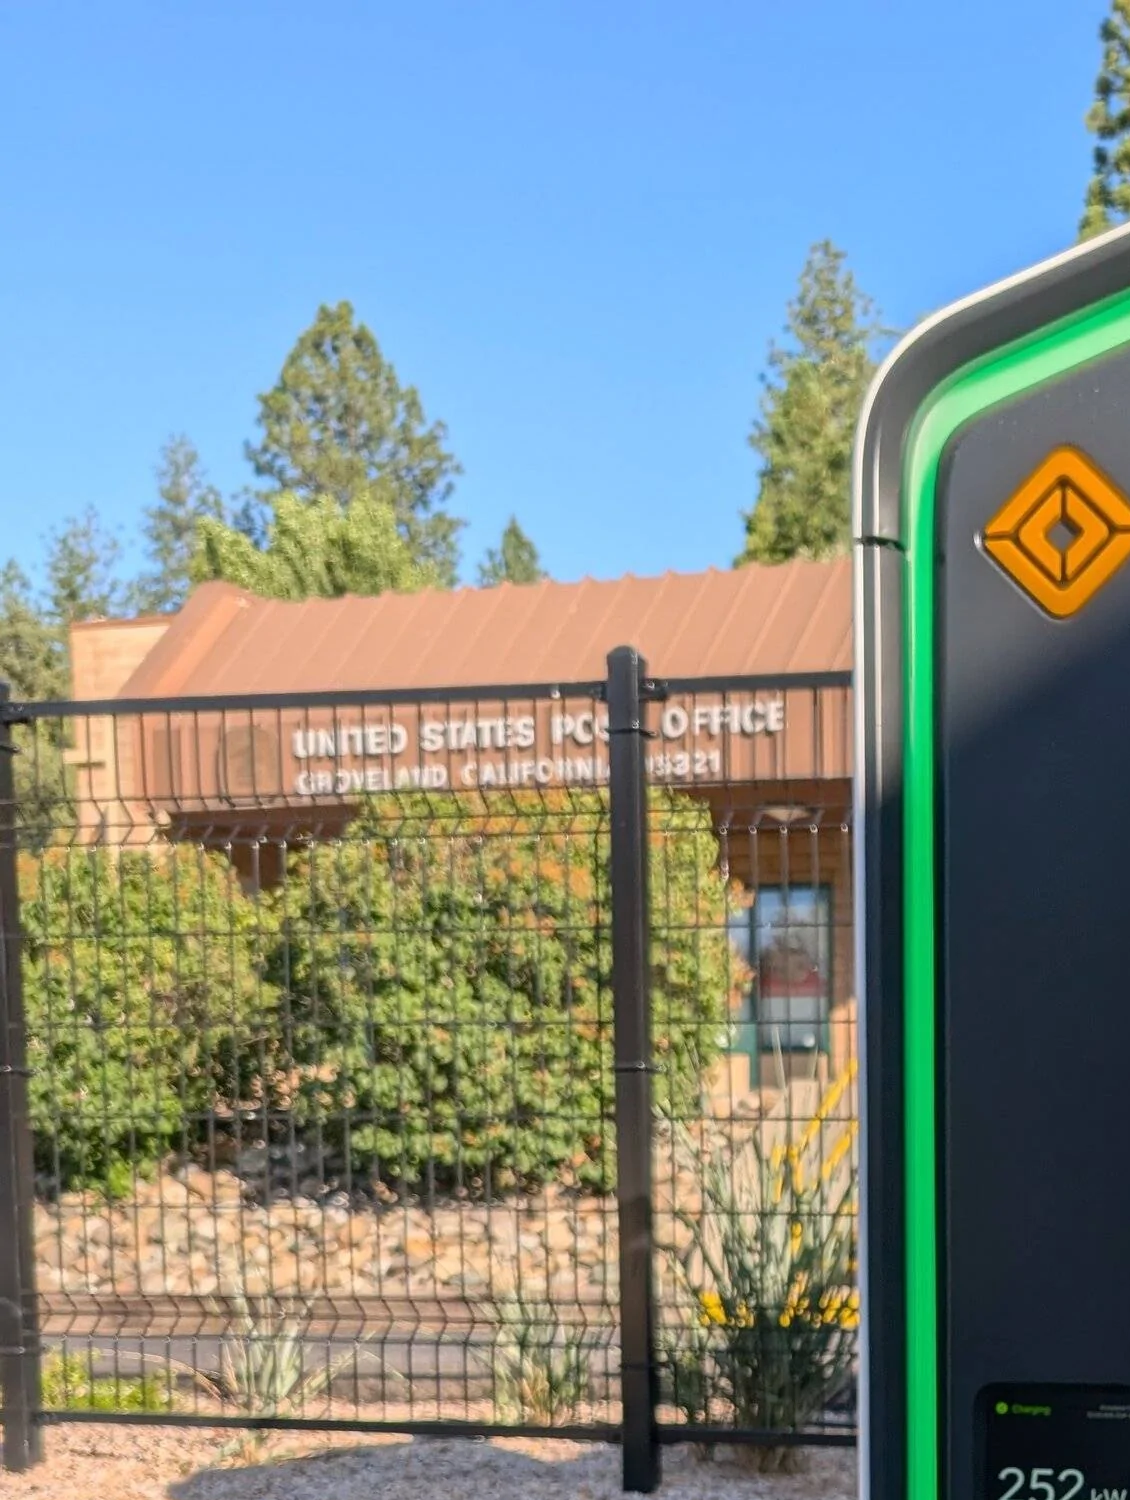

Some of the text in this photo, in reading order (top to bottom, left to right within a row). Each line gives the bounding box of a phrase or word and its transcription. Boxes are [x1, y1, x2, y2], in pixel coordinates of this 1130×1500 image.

[292, 699, 785, 759] UNITED STATES POS OFFICE
[296, 763, 449, 795] GROVELAND
[460, 756, 610, 787] CALIFORNI
